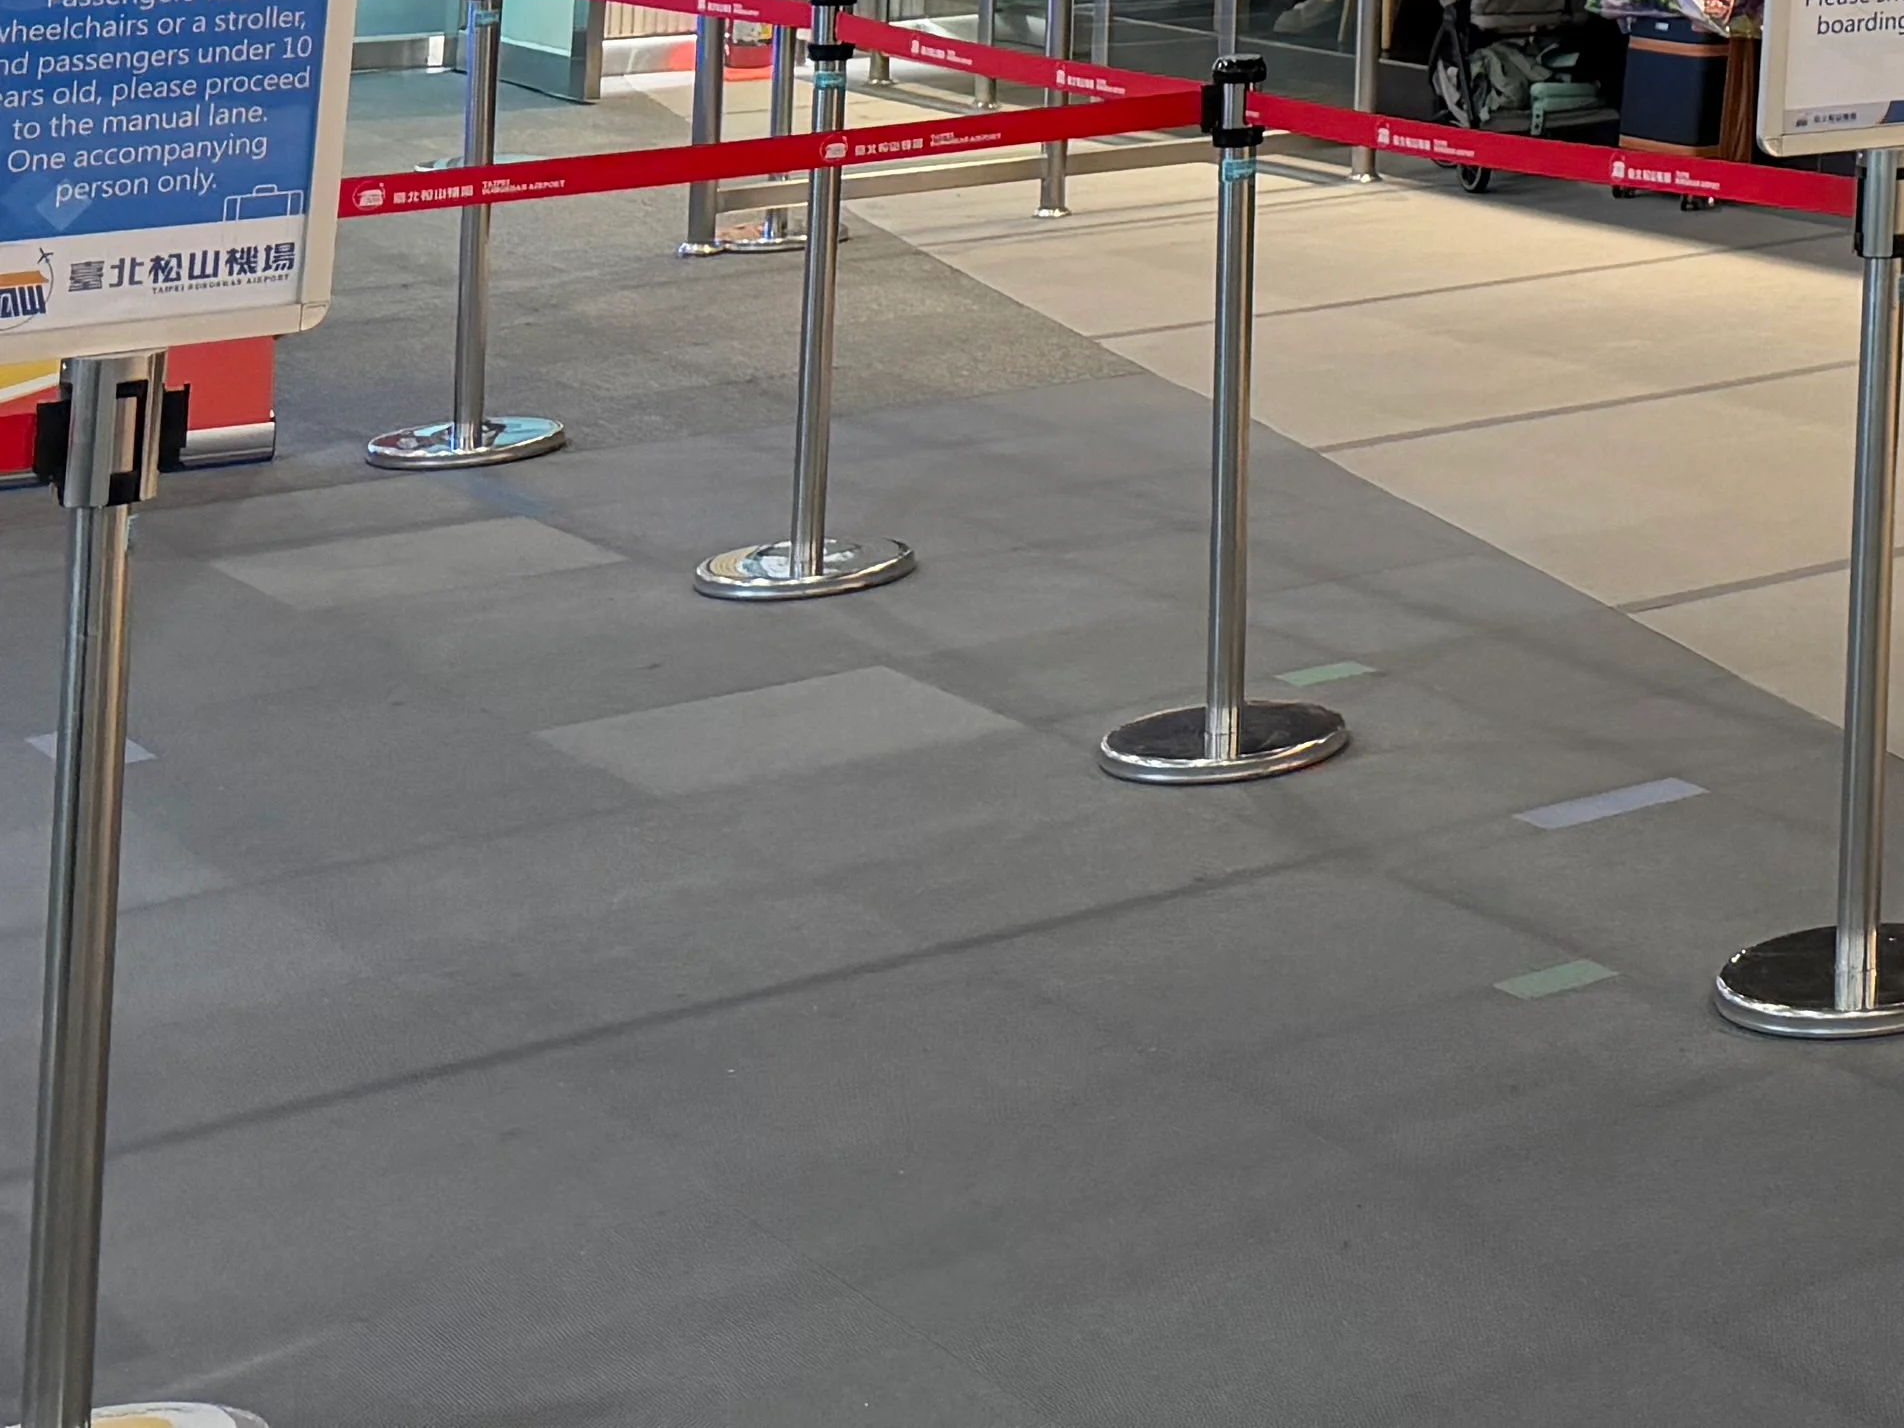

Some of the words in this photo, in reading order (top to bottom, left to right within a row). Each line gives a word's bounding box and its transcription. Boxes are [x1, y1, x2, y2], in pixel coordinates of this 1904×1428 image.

[157, 17, 185, 35] or
[192, 17, 206, 33] a
[215, 6, 306, 32] stroller,
[37, 48, 190, 80] passengers
[198, 41, 276, 64] under
[283, 36, 313, 58] 10
[53, 81, 102, 105] old,
[112, 75, 197, 108] please
[204, 70, 311, 100] proceed
[13, 118, 41, 140] to
[50, 112, 94, 137] the
[103, 105, 200, 134] manual
[209, 102, 268, 127] lane.
[7, 150, 66, 172] One
[73, 134, 268, 167] accompanying
[55, 177, 148, 207] person
[158, 171, 217, 196] only.
[68, 242, 296, 293] 臺北松山機場
[152, 283, 185, 294] TAIPEI
[246, 273, 289, 285] AIRPORT
